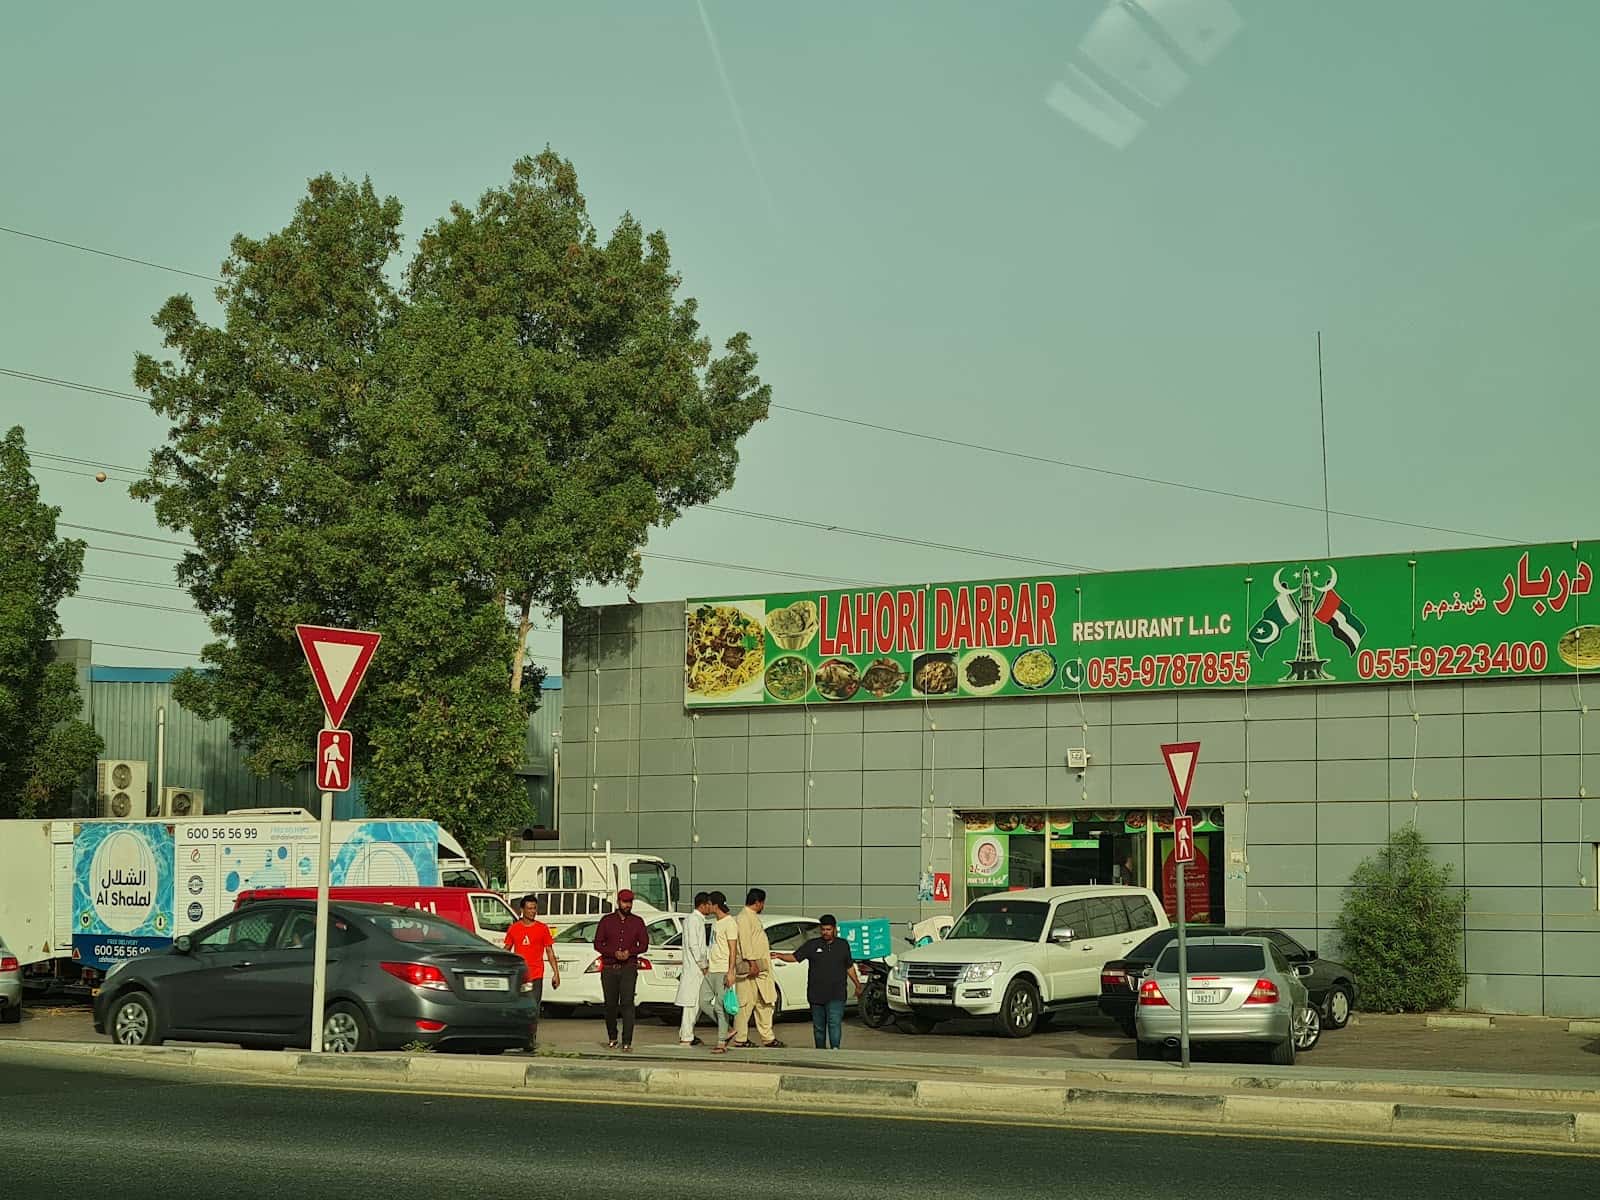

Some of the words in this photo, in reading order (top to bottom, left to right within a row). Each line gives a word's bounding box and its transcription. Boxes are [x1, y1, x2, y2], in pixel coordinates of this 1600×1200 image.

[1493, 551, 1593, 617] دربار
[819, 589, 926, 656] LAHORI
[934, 582, 1057, 651] DARBAR
[1072, 616, 1184, 642] RESTAURANT
[1189, 613, 1232, 636] L.L.C
[1087, 651, 1251, 689] 055-9787855
[1357, 640, 1548, 680] 055-9223400
[187, 828, 209, 839] 600
[212, 828, 225, 839] 56
[228, 828, 242, 839] 56
[244, 828, 258, 839] 99
[101, 868, 146, 889] الشلال
[96, 890, 108, 905] Al
[111, 890, 151, 907] Shalal
[94, 945, 113, 956] 600
[113, 946, 125, 956] 56
[126, 946, 138, 957] 56
